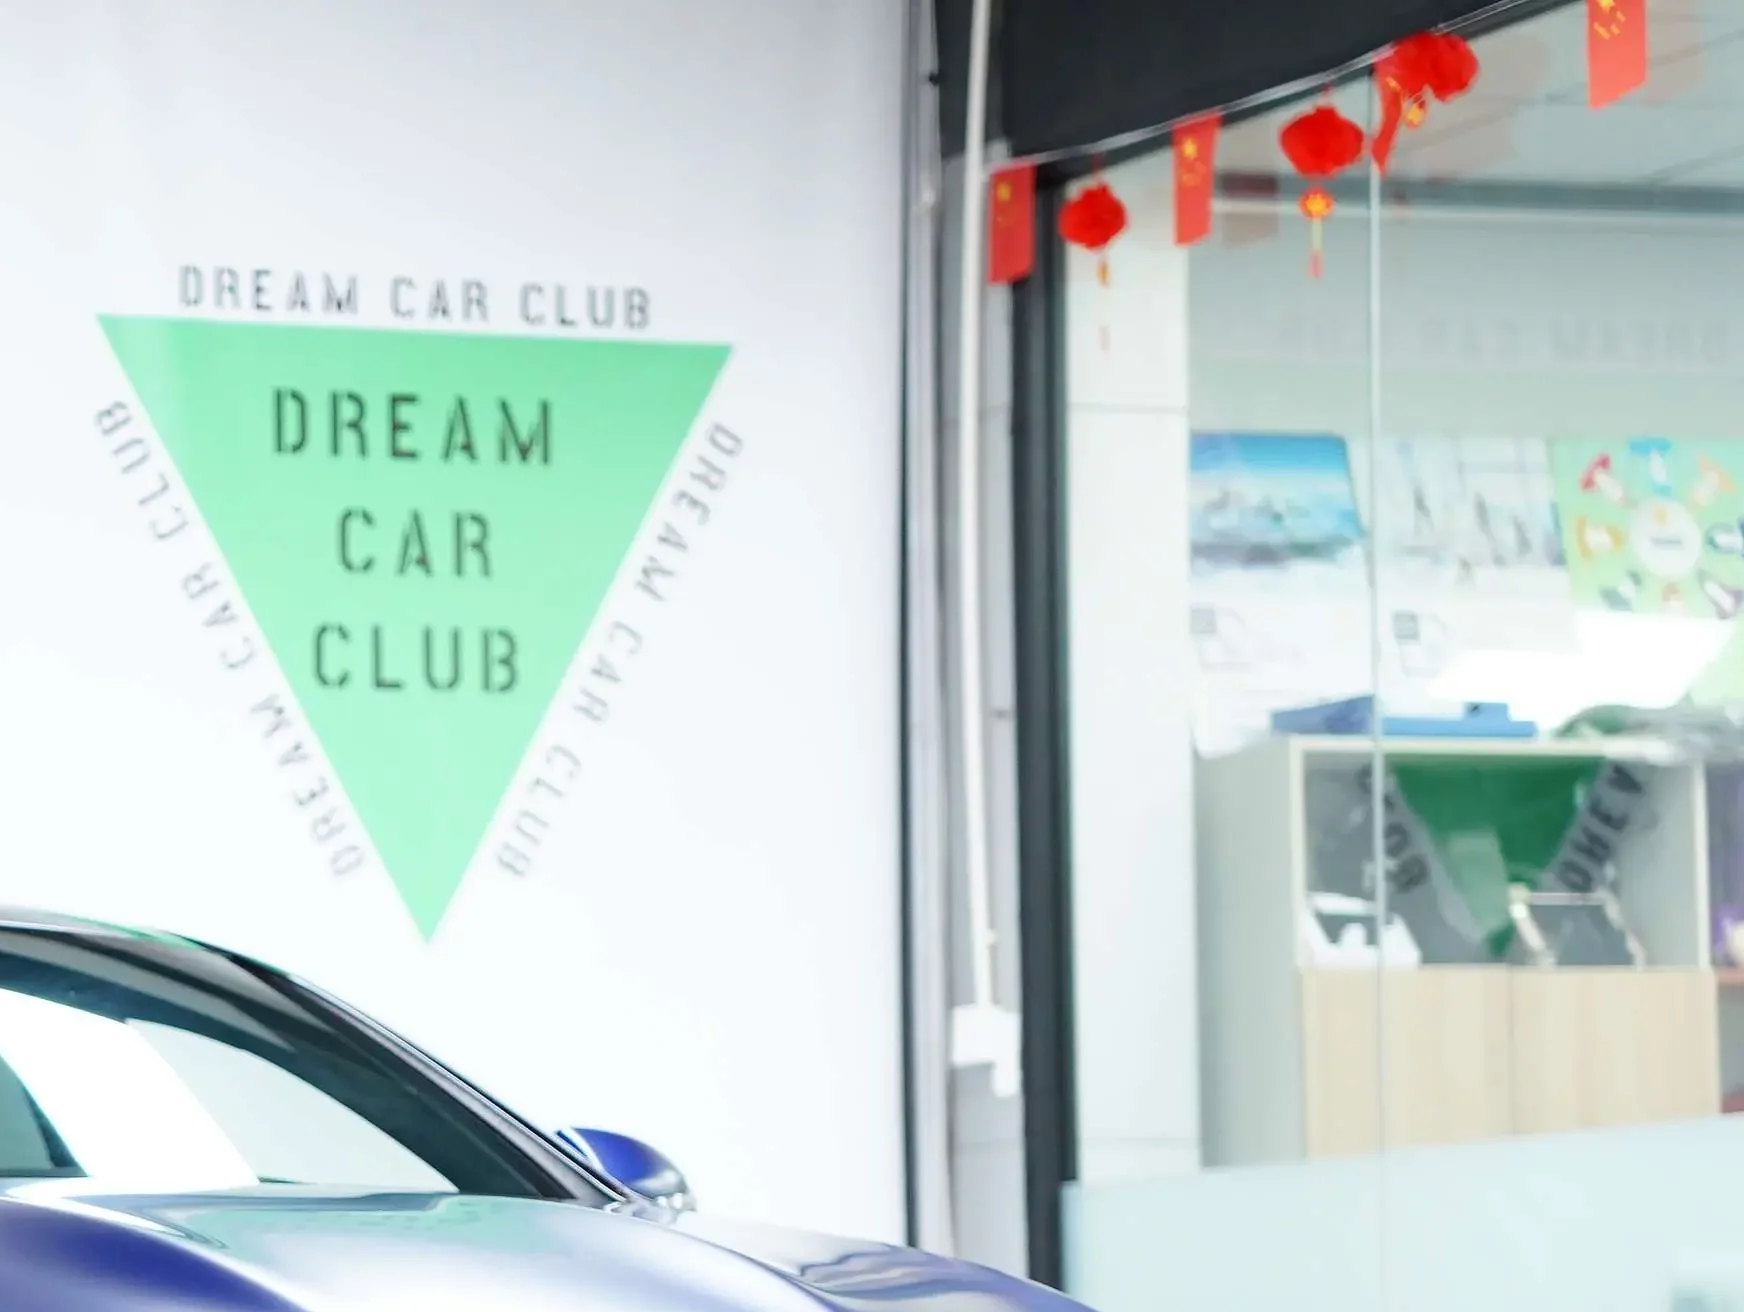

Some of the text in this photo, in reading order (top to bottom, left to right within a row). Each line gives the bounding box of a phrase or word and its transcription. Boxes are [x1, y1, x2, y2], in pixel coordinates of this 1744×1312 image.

[179, 264, 651, 331] DREAM CAR CLUB
[272, 387, 553, 466] DREAM
[337, 507, 493, 579] CAR
[94, 400, 364, 877] DREAM CAR CLUB
[313, 622, 519, 694] CLUB
[496, 421, 744, 878] DREAM CAR CLUB
